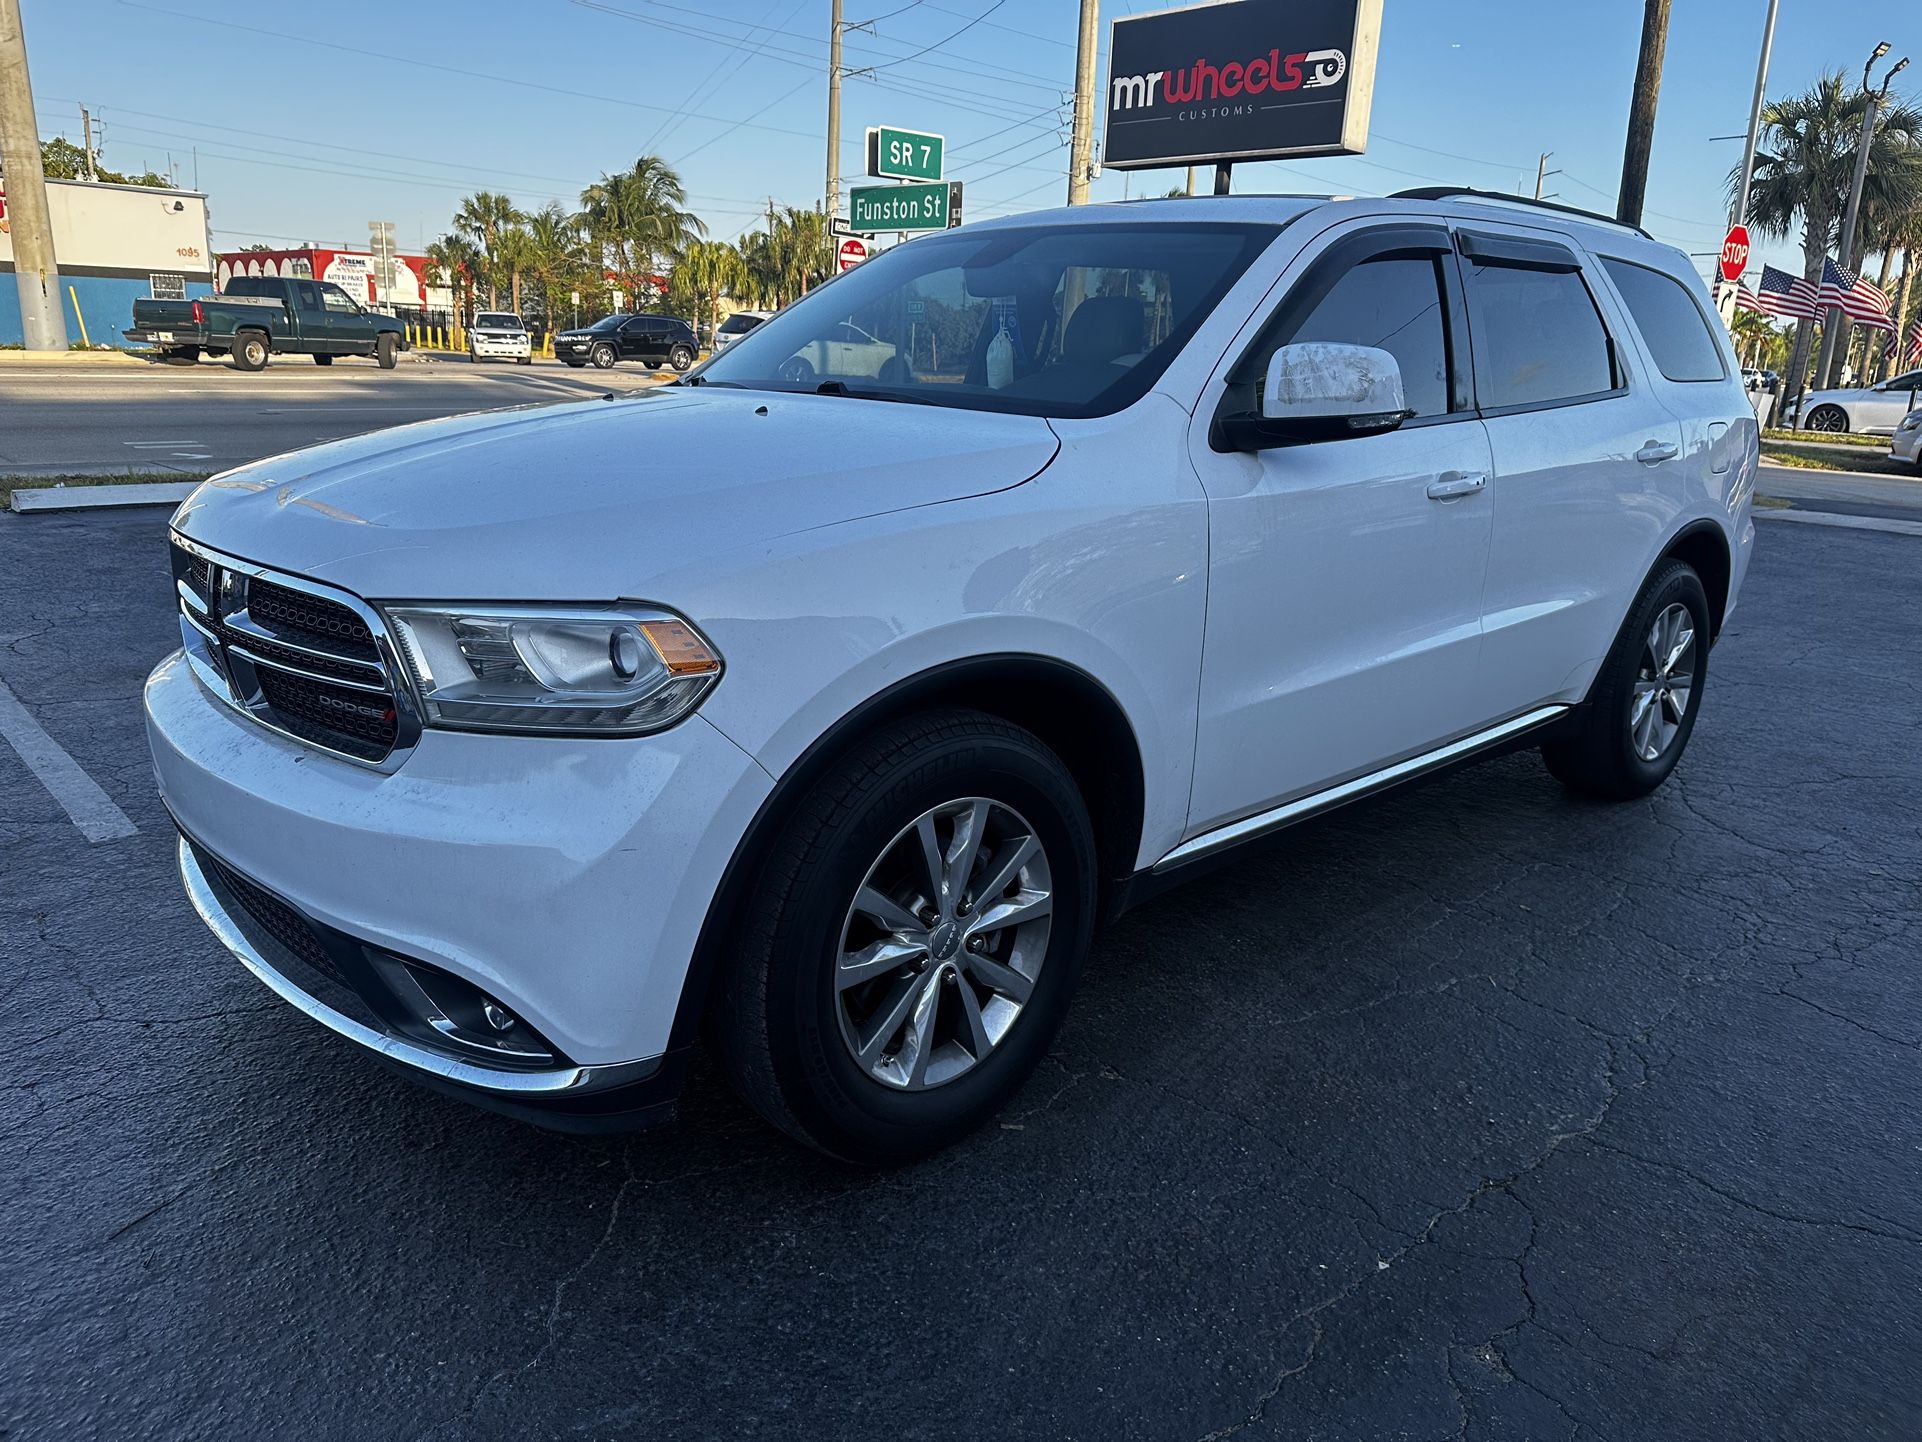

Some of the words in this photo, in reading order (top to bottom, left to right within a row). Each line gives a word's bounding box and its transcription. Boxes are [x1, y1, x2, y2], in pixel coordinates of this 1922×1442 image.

[1178, 103, 1254, 121] CUSTOMS
[889, 140, 913, 167] SR
[920, 145, 931, 169] 7
[856, 197, 918, 221] Funston
[923, 194, 941, 218] St
[836, 222, 849, 230] ONE
[176, 247, 200, 258] 1095
[843, 245, 851, 253] DO
[853, 246, 864, 254] NOT
[1723, 241, 1748, 265] STOP
[327, 273, 341, 281] AUTO
[320, 695, 385, 719] DODGE
